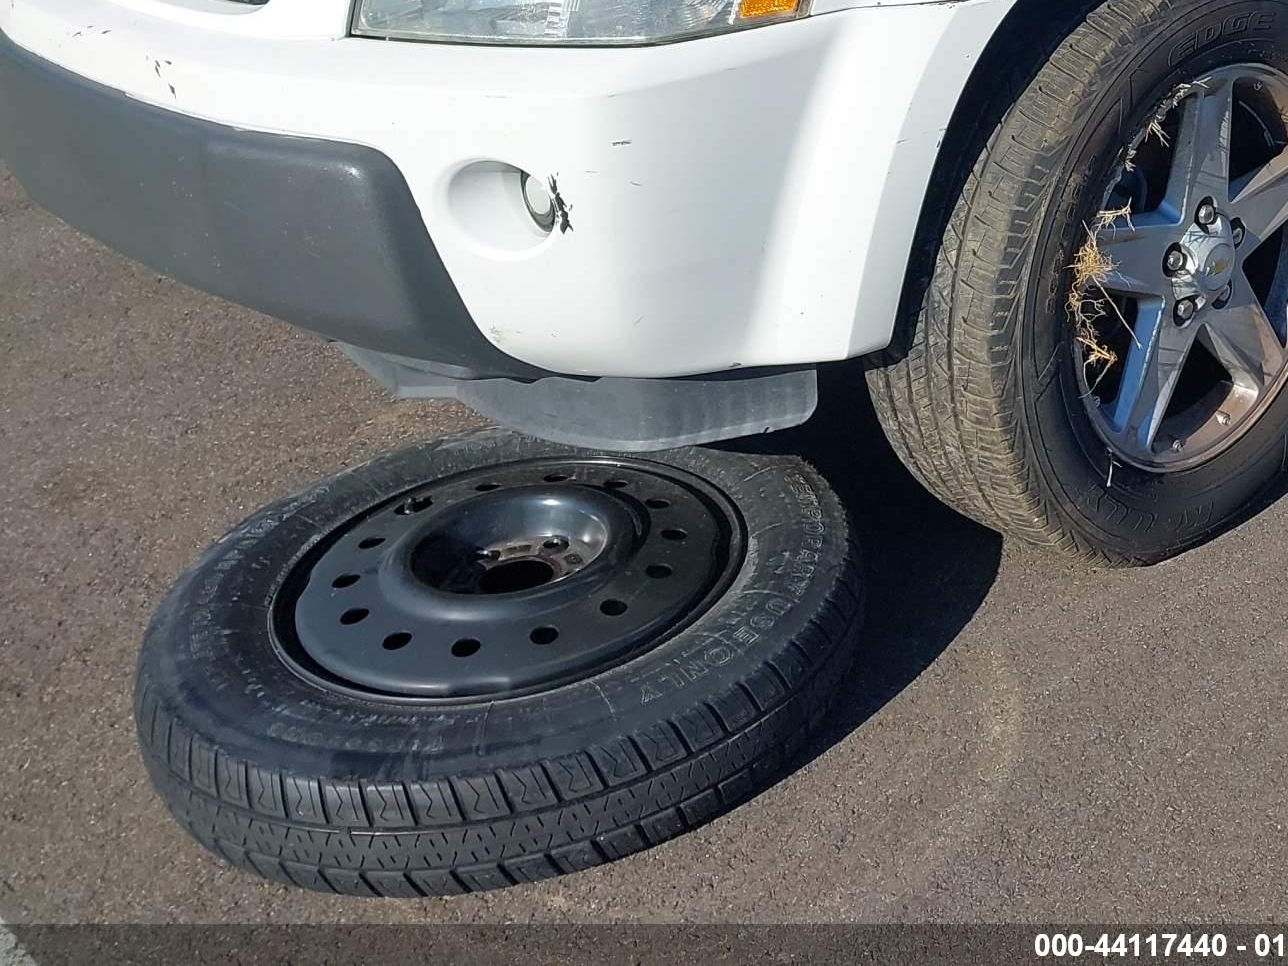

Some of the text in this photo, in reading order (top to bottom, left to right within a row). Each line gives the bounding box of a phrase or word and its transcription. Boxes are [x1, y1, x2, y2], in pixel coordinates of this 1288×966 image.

[1168, 11, 1276, 67] EDGE
[733, 598, 792, 644] USE
[641, 647, 734, 704] ONLY
